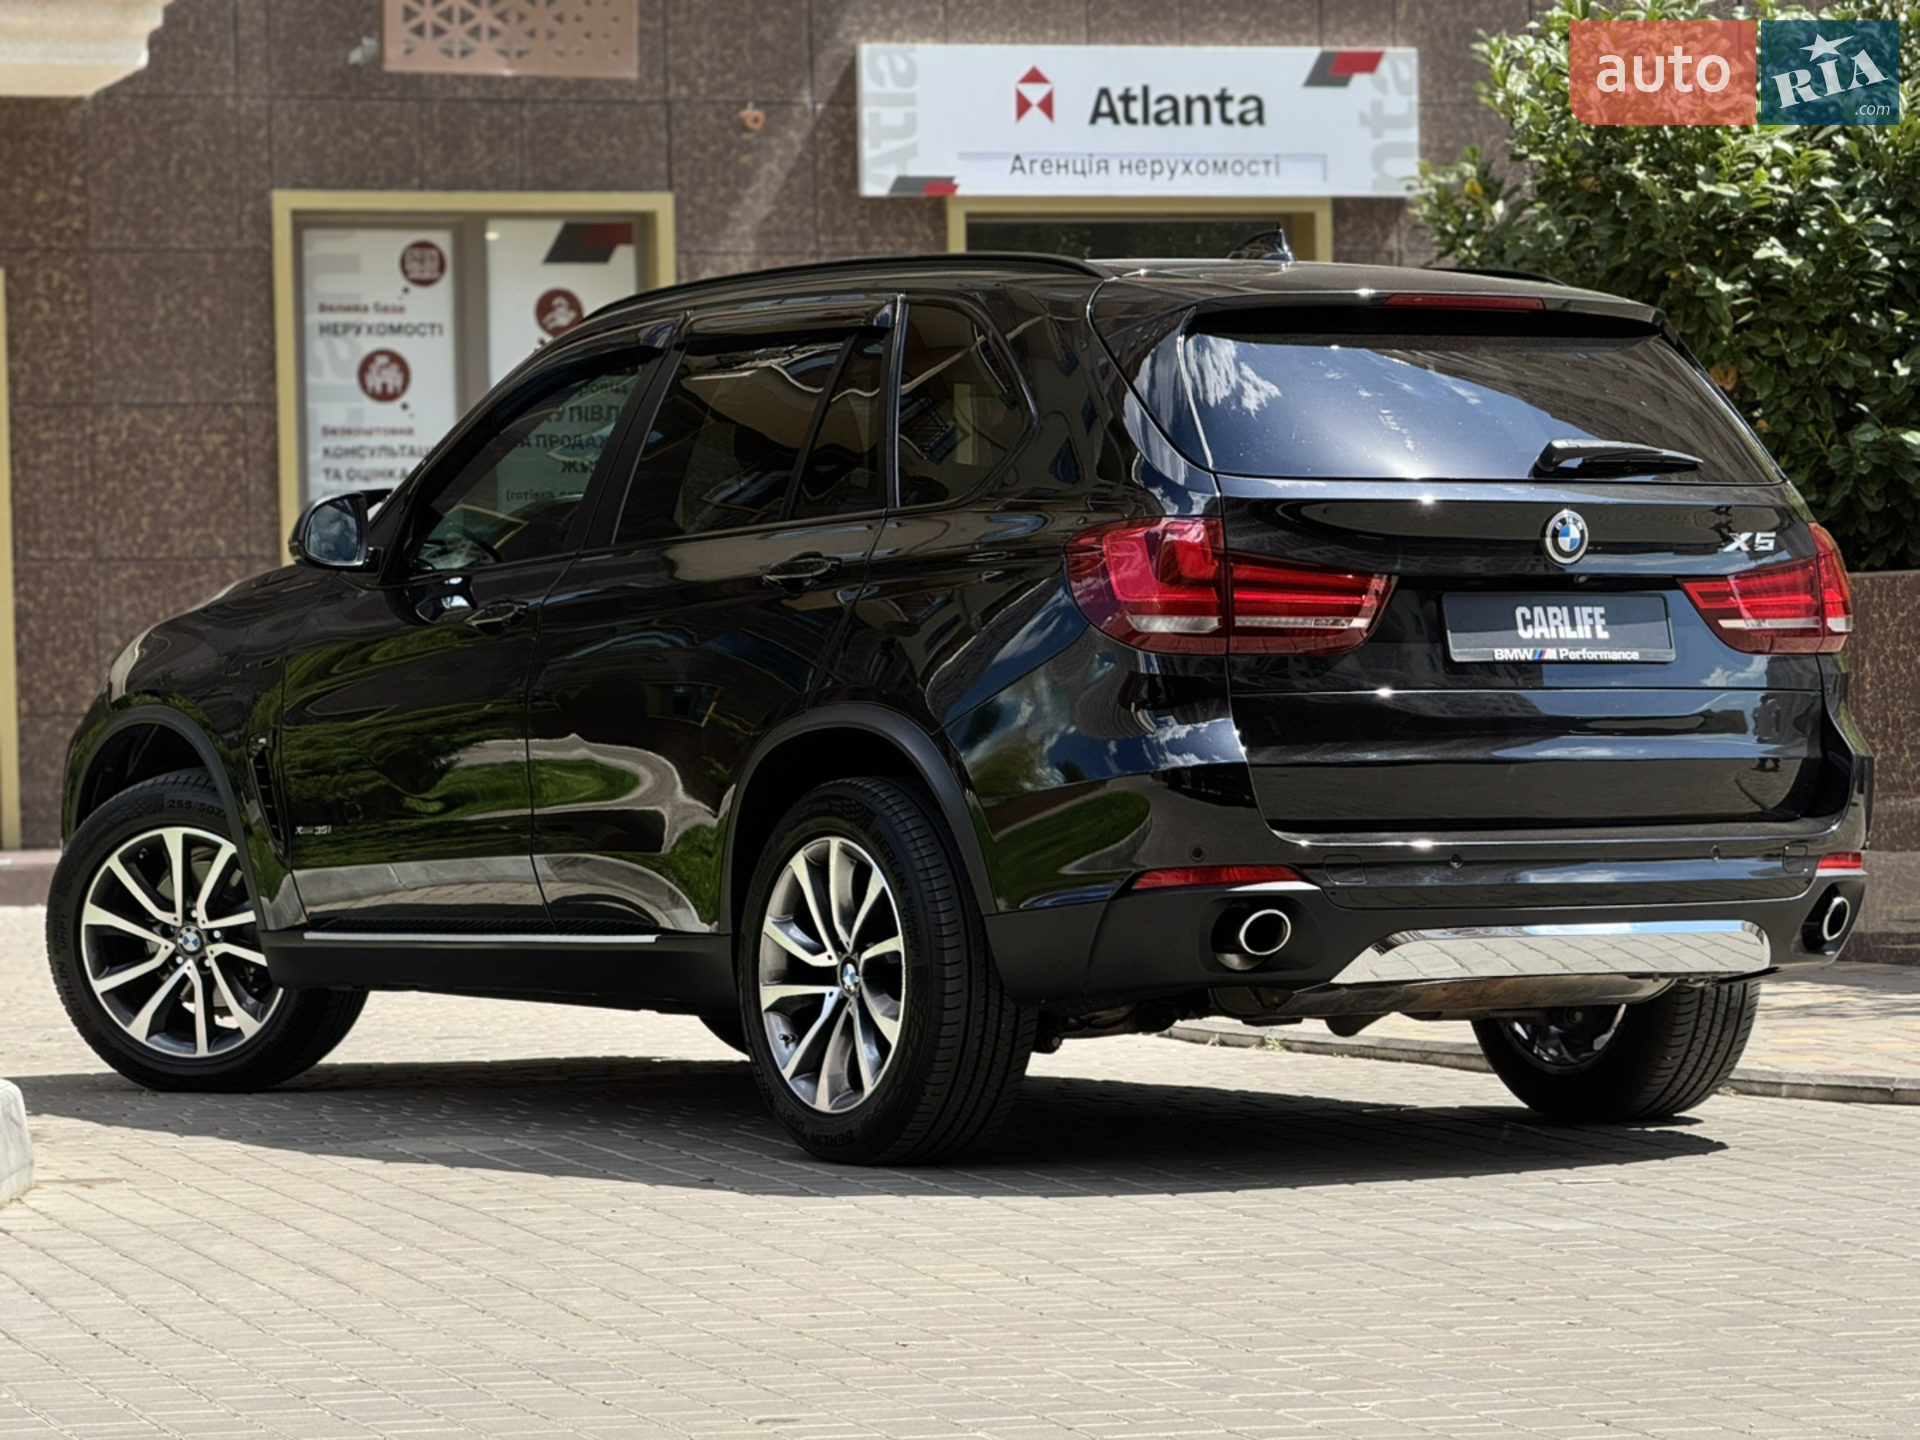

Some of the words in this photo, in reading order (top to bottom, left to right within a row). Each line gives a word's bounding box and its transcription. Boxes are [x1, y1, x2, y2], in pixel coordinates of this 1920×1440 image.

[1088, 84, 1265, 126] Atlanta
[1010, 153, 1110, 178] Агенція
[1119, 154, 1281, 179] нерухомості
[319, 322, 443, 337] НЕРУХОМОСТІ
[579, 380, 628, 396] ровід
[323, 468, 342, 482] ТА
[1723, 531, 1776, 552] X5
[1515, 606, 1609, 639] CARLIFE
[1494, 648, 1534, 660] BMW
[1559, 648, 1639, 660] Performance
[871, 829, 909, 893] BERLIN
[809, 1130, 856, 1148] BERLIN
